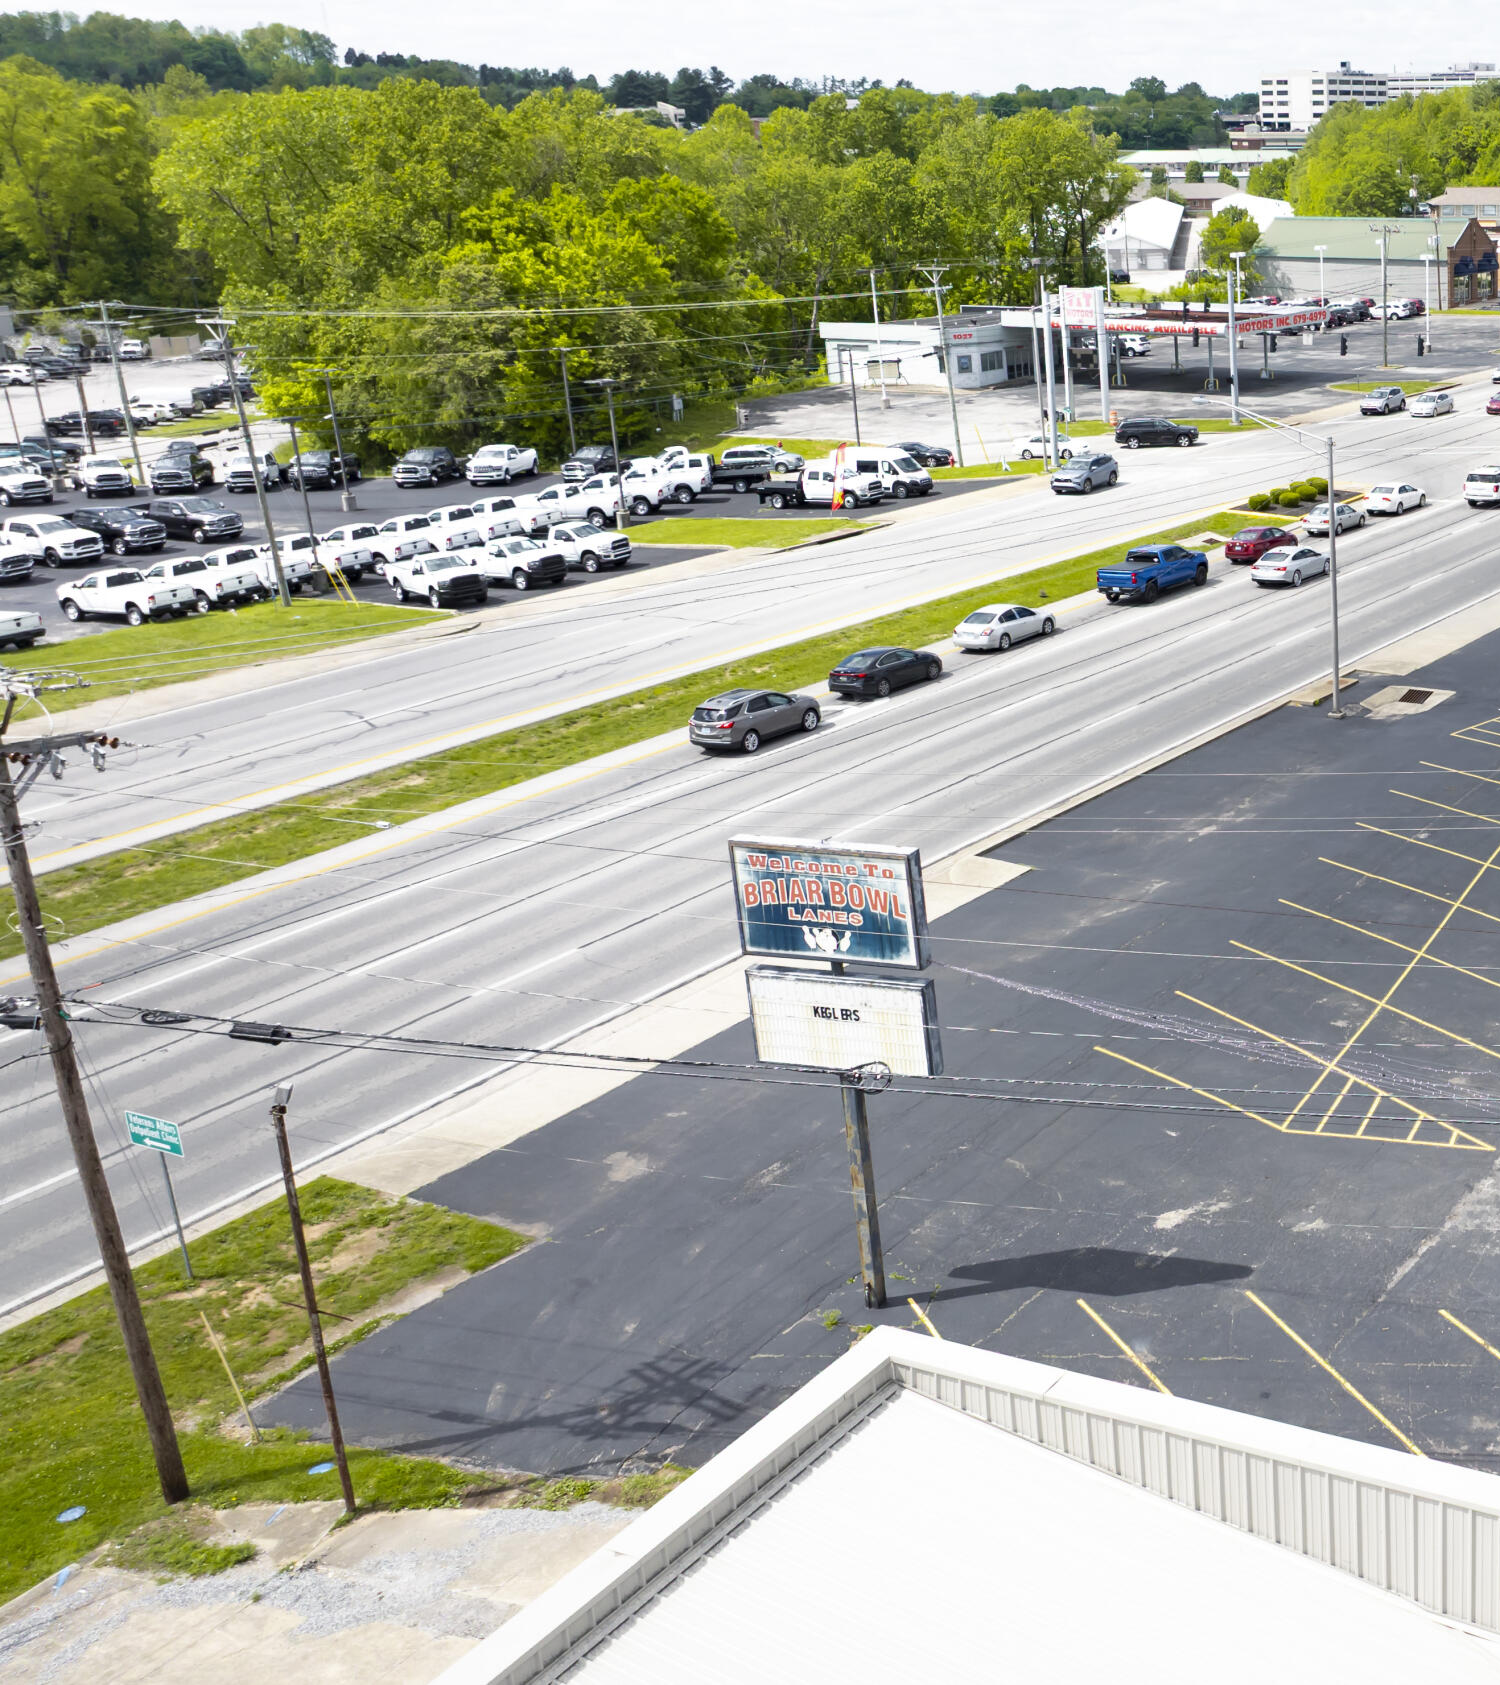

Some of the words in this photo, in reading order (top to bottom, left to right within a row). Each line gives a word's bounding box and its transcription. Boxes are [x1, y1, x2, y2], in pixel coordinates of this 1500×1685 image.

[1239, 317, 1274, 333] MOTORS
[1293, 310, 1327, 324] 679-4979
[747, 854, 859, 877] Welcome
[863, 863, 894, 880] To
[743, 877, 825, 908] BRIAR
[828, 879, 907, 920] BOWL
[788, 907, 864, 926] LANES
[813, 1006, 860, 1022] KEGLERS
